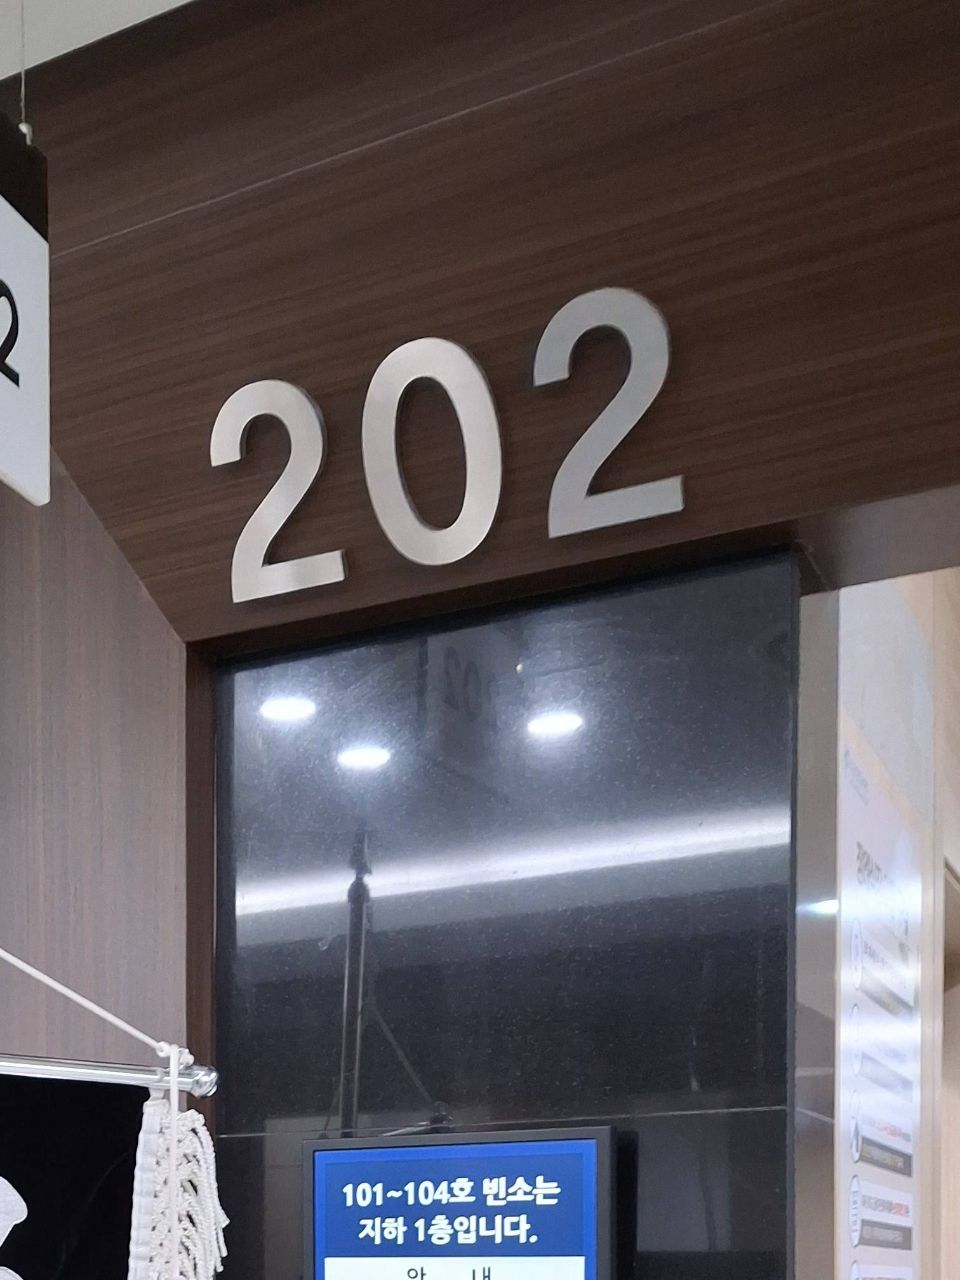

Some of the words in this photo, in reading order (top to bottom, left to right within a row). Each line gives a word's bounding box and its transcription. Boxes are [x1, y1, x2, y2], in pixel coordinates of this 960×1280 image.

[209, 286, 685, 604] 202
[342, 1177, 476, 1207] 101~104호
[482, 1175, 562, 1205] 빈소는
[358, 1215, 408, 1245] 지하
[414, 1214, 539, 1245] 1층입니다.
